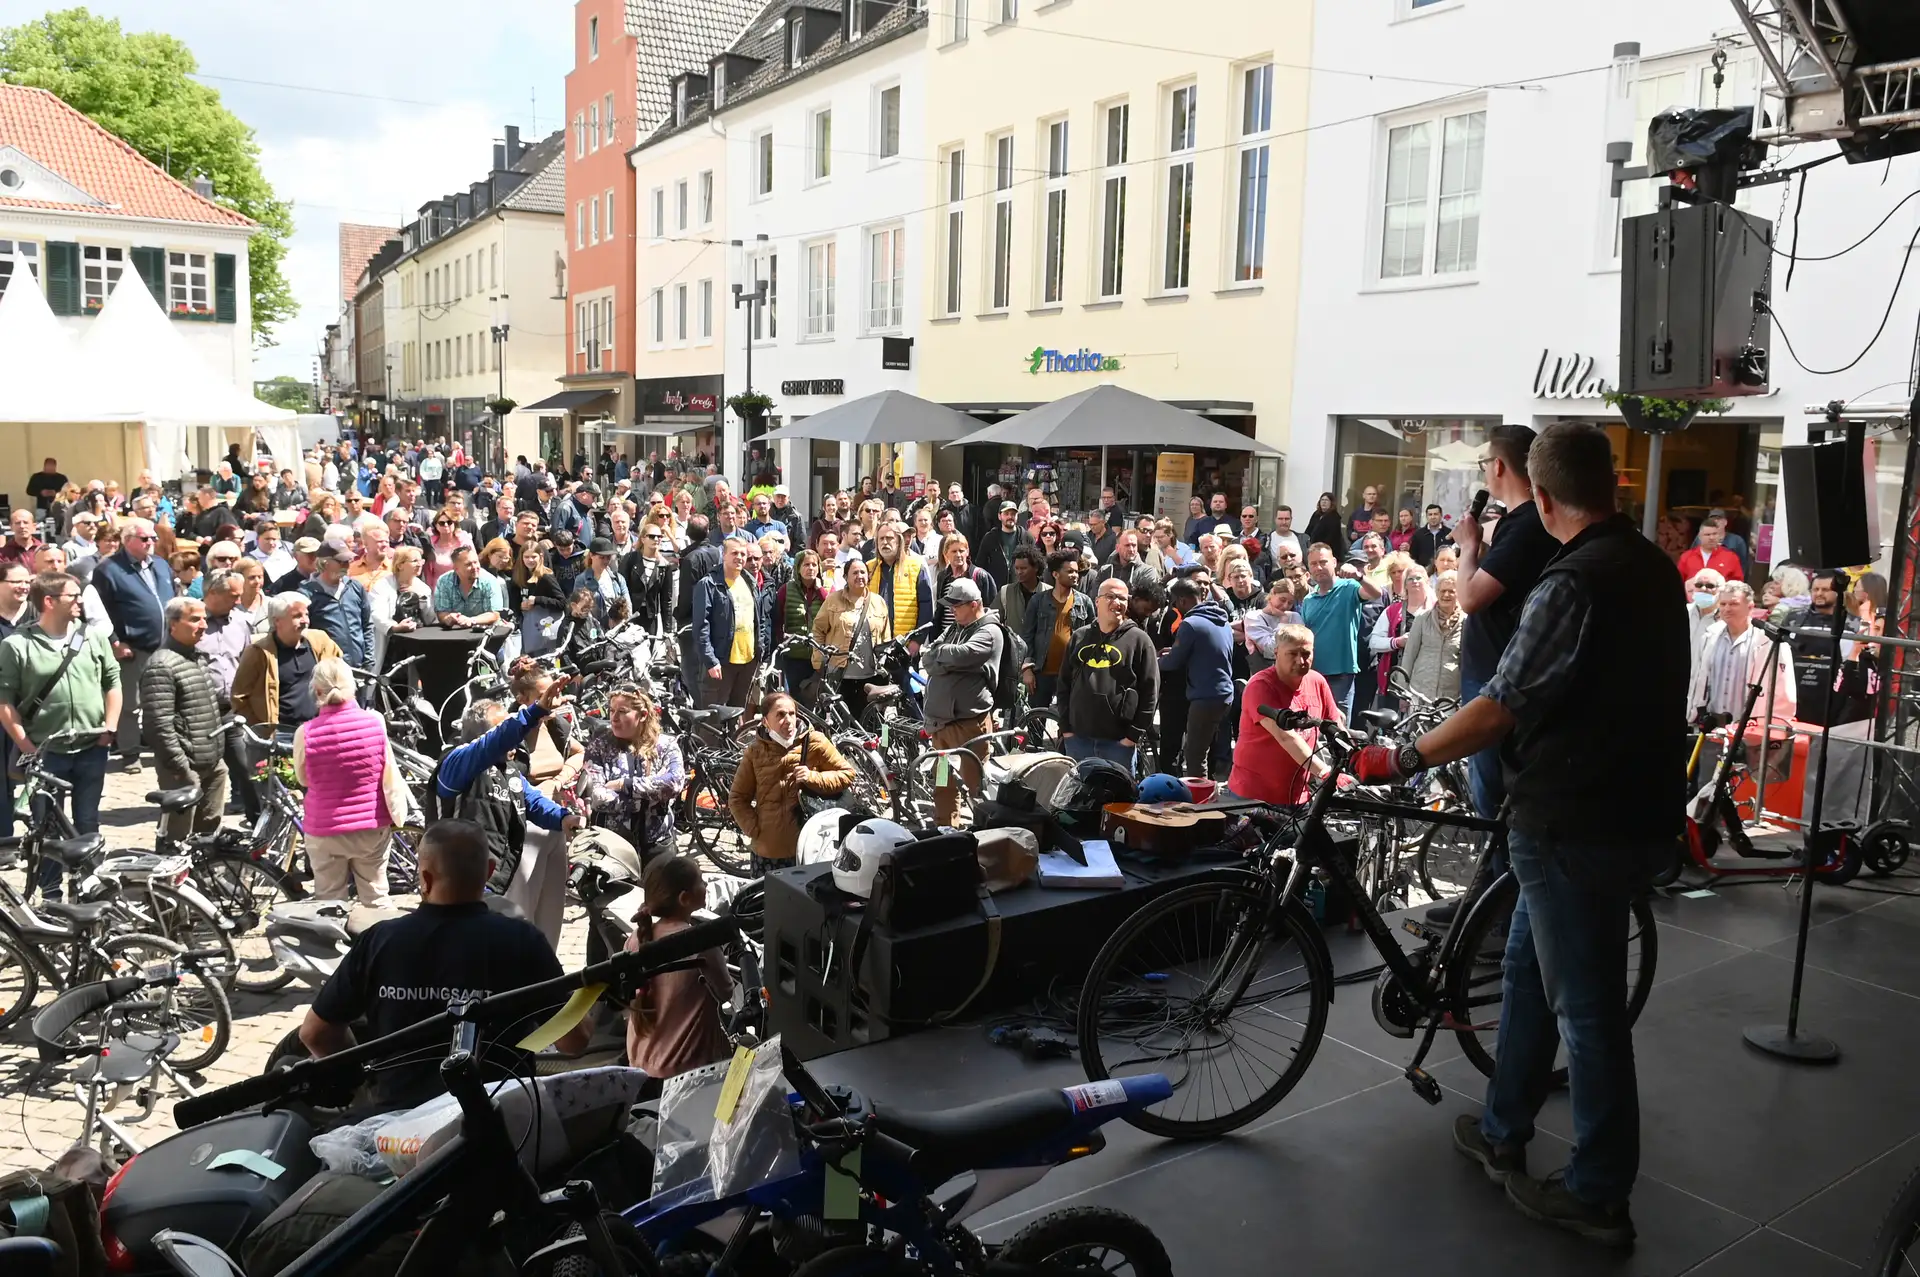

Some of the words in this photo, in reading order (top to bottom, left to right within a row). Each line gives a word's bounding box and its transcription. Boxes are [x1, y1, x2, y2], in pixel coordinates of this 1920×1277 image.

[781, 380, 810, 396] GERRY
[810, 379, 844, 395] WEBER
[1533, 349, 1604, 399] Ulla
